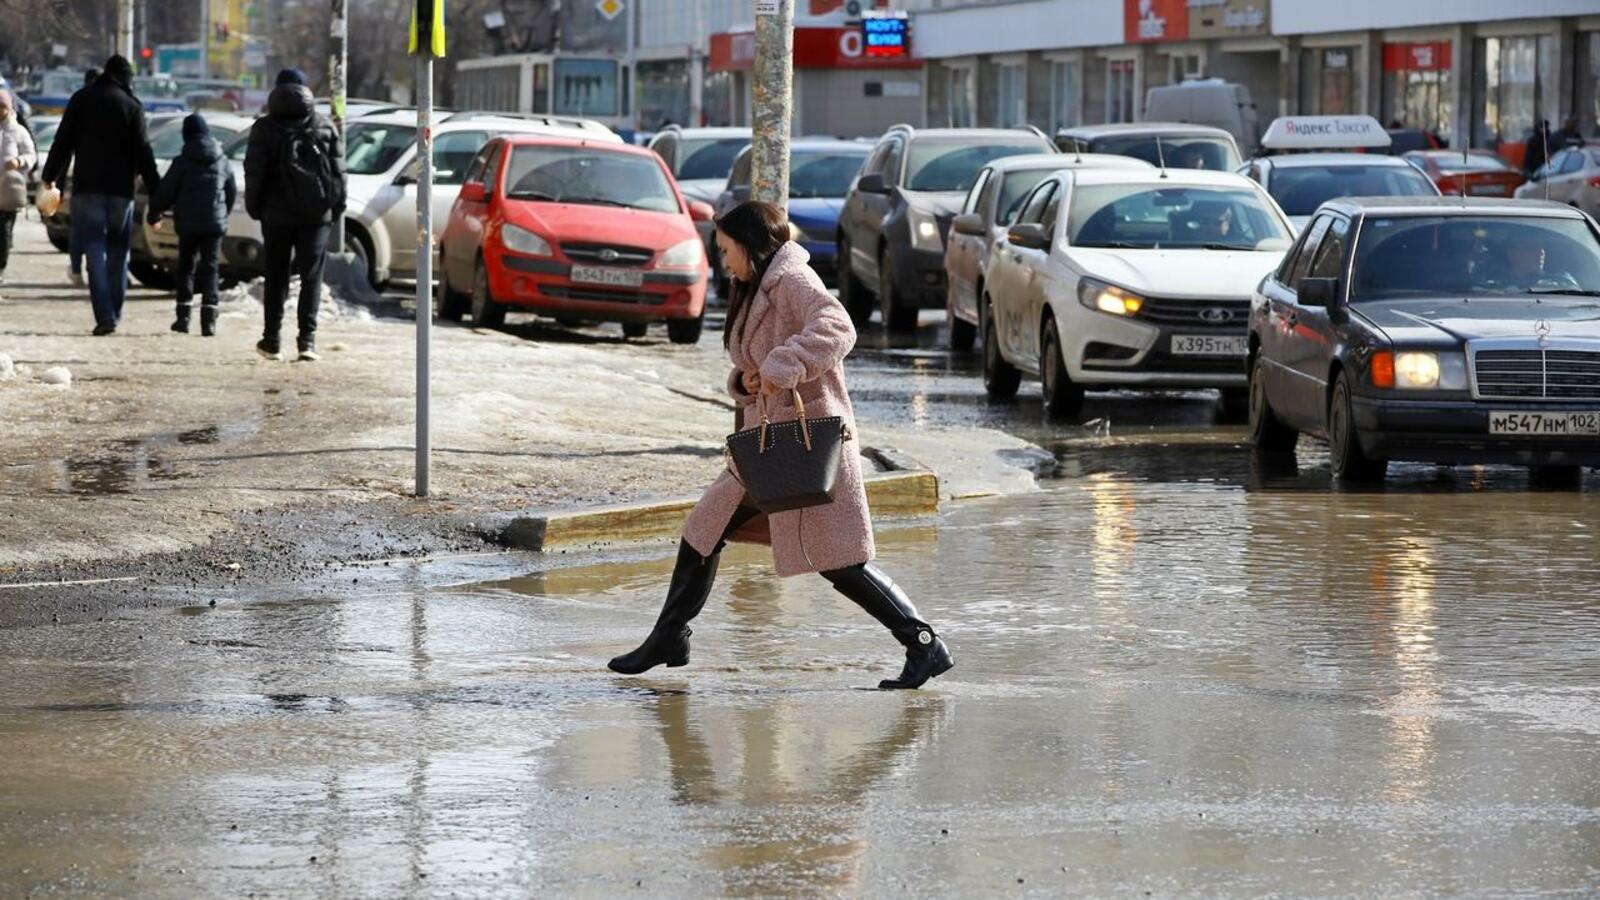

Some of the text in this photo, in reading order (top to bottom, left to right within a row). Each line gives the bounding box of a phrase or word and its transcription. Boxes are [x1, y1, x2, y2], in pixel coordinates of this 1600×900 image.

[1286, 120, 1370, 135] Яндекс Такси
[1569, 414, 1595, 428] 102
